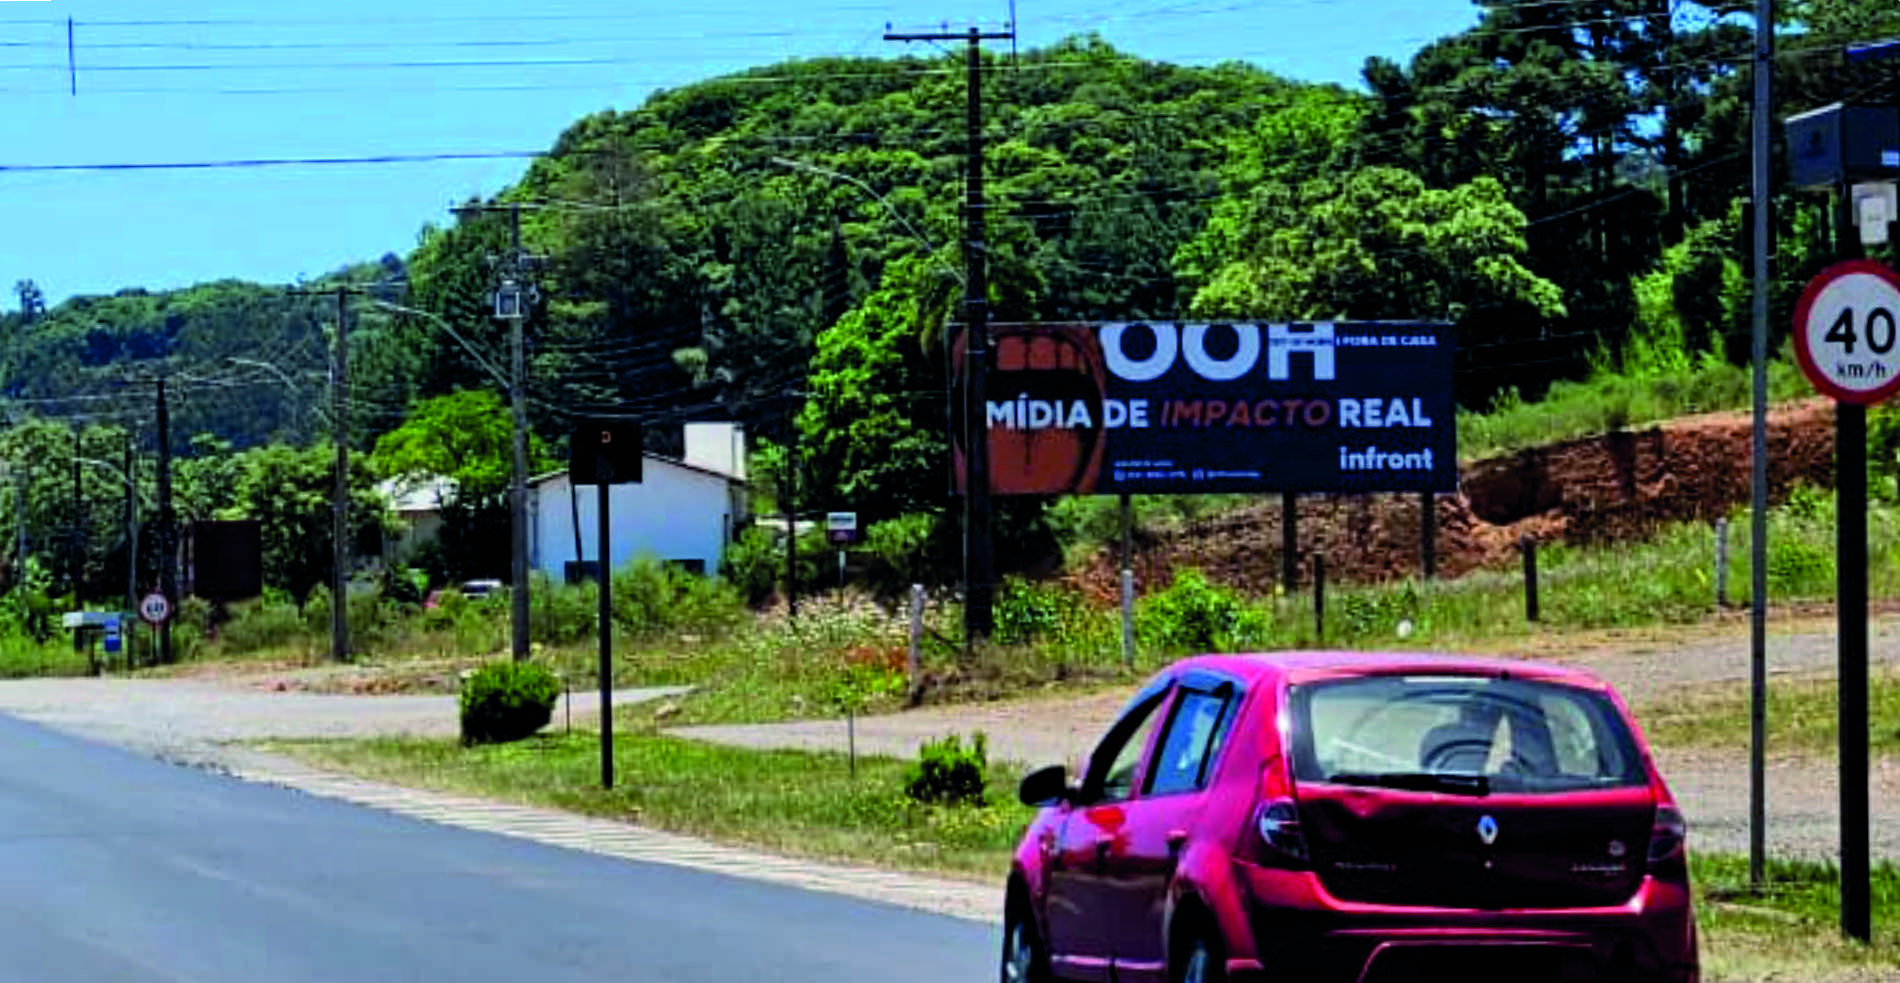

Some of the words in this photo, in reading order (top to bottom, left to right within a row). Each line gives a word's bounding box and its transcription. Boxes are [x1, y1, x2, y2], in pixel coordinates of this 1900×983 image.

[1824, 307, 1896, 354] 40
[1101, 323, 1335, 381] OOH
[1836, 361, 1886, 378] km/h
[986, 392, 1092, 430] MÍDIA
[1103, 399, 1149, 428] DE
[1160, 399, 1331, 428] IMPACTO
[1339, 398, 1432, 428] REAL
[1340, 446, 1433, 470] infront
